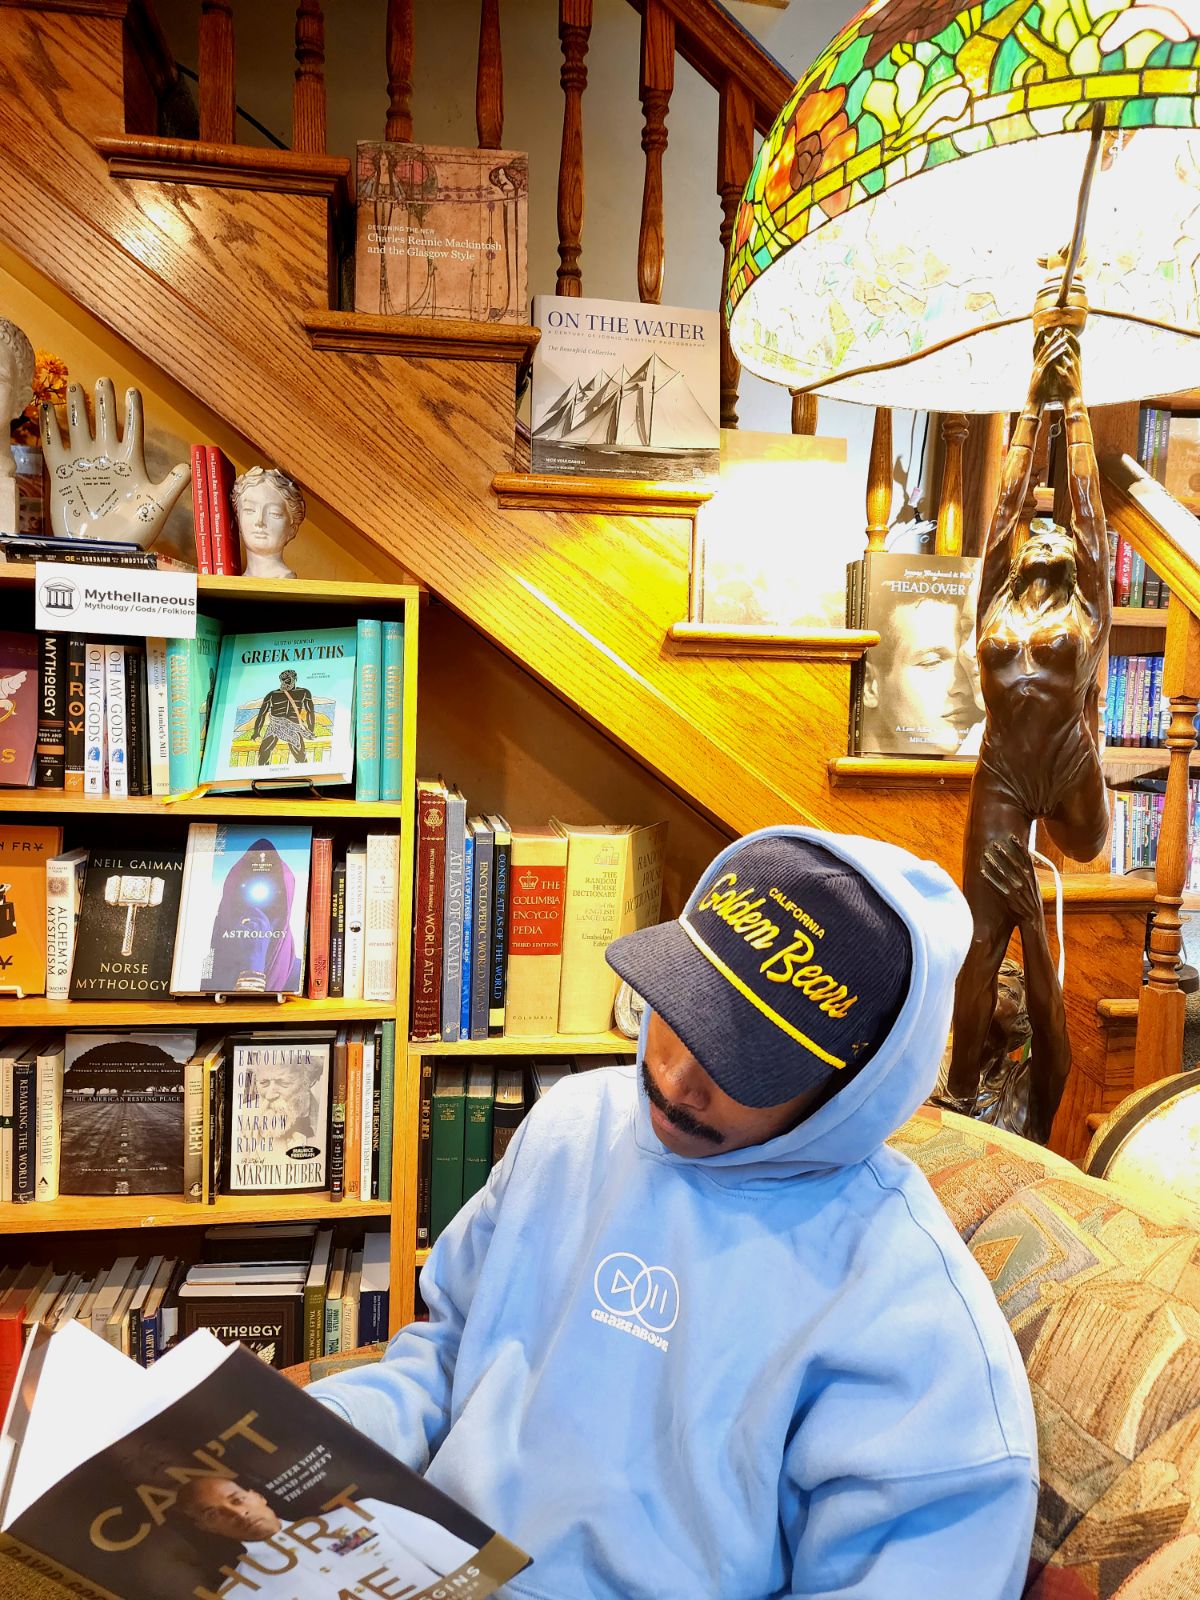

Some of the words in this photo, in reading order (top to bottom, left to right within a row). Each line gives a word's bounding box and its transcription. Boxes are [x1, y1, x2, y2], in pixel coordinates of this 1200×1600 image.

[368, 233, 405, 244] Charles
[408, 237, 442, 246] Rennie
[446, 238, 501, 250] Mackintosh
[368, 246, 385, 254] and
[389, 247, 404, 255] the
[407, 248, 448, 259] Glasgow
[452, 251, 475, 261] Style
[548, 311, 579, 328] ON
[586, 314, 629, 334] THE
[634, 319, 705, 341] WATER
[85, 589, 195, 606] Mythellaneous
[890, 580, 929, 593] HEAD
[931, 583, 966, 595] OVER
[85, 602, 128, 611] Mythology
[163, 607, 195, 615] Folklore
[89, 650, 101, 672] OH
[110, 651, 121, 673] OH
[242, 649, 290, 664] GREEK
[293, 645, 344, 659] MYTHS
[45, 638, 56, 716] MYTHOLOGY
[171, 656, 189, 703] GREEK
[89, 678, 100, 699] MY
[110, 679, 122, 700] MY
[89, 702, 100, 742] GODS
[111, 704, 123, 743] GODS
[158, 706, 166, 740] Hamlet's
[171, 706, 189, 755] MYTHS
[94, 858, 127, 869] NEIL
[130, 860, 183, 871] GAIMAN
[448, 850, 463, 897] ATLAS
[497, 854, 507, 894] CONCISE
[542, 880, 560, 890] THE
[573, 890, 616, 898] DICTIONARY
[448, 900, 461, 919] OF
[478, 861, 489, 939] ENCYCLOPEDIC
[513, 895, 561, 905] COLUMBIA
[496, 898, 505, 926] ATLAS
[513, 910, 560, 920] ENCYCLO-
[769, 887, 825, 939] CALIFORNIA
[48, 906, 56, 975] MYSTICISM
[57, 907, 68, 966] ALCHEMY
[222, 930, 287, 938] ASTROLOGY
[424, 913, 436, 957] WORLD
[496, 928, 504, 941] OF
[513, 925, 542, 934] PEDIA
[447, 923, 461, 981] CANADA
[495, 944, 504, 962] THE
[698, 872, 780, 951] Golden
[760, 929, 859, 1019] Bears
[100, 963, 149, 975] NORSE
[423, 960, 434, 993] ATLAS
[76, 977, 170, 992] MYTHOLOGY
[493, 965, 502, 999] WORLD
[239, 1049, 311, 1067] ENCOUNTER
[42, 1068, 53, 1083] THE
[239, 1070, 254, 1087] ON
[18, 1079, 28, 1129] REMAKING
[42, 1089, 53, 1130] FARTHER
[238, 1093, 260, 1109] THE
[188, 1105, 203, 1156] GILBERT
[237, 1114, 288, 1131] NARROW
[18, 1132, 27, 1150] THE
[42, 1136, 52, 1165] SHORE
[237, 1137, 274, 1152] RIDGE
[18, 1151, 27, 1188] WORLD
[235, 1164, 282, 1186] MARTIN
[285, 1163, 322, 1185] BUBER
[146, 1335, 154, 1348] GIFT
[265, 1465, 300, 1490] MASTER
[298, 1445, 326, 1466] YOUR
[275, 1479, 298, 1496] MIND
[309, 1453, 332, 1473] DEFY
[90, 1409, 278, 1552] CAN'T
[193, 1483, 375, 1600] HURT
